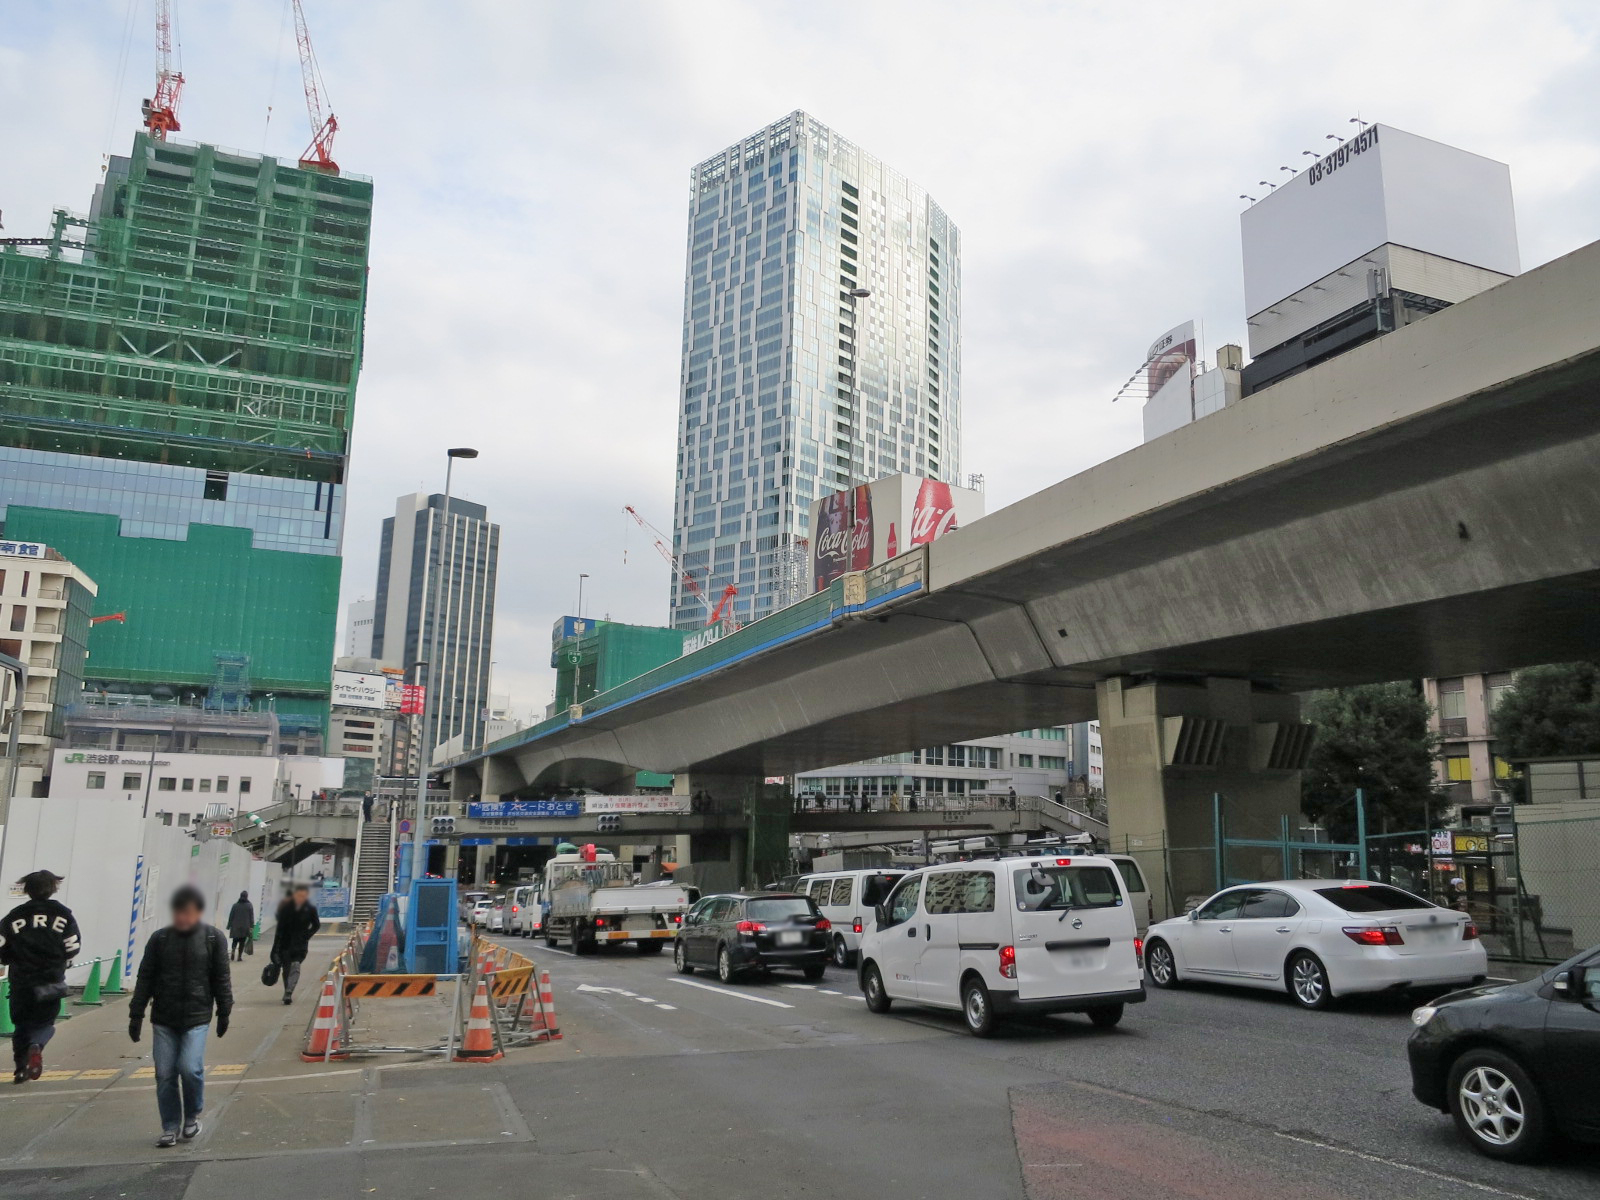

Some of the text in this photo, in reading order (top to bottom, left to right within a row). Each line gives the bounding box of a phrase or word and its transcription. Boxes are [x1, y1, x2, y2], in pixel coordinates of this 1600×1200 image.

[1309, 125, 1379, 186] 03-3797-4571
[817, 516, 870, 559] Coca-Cola
[65, 753, 85, 764] JR
[86, 754, 120, 765] 渋谷駅
